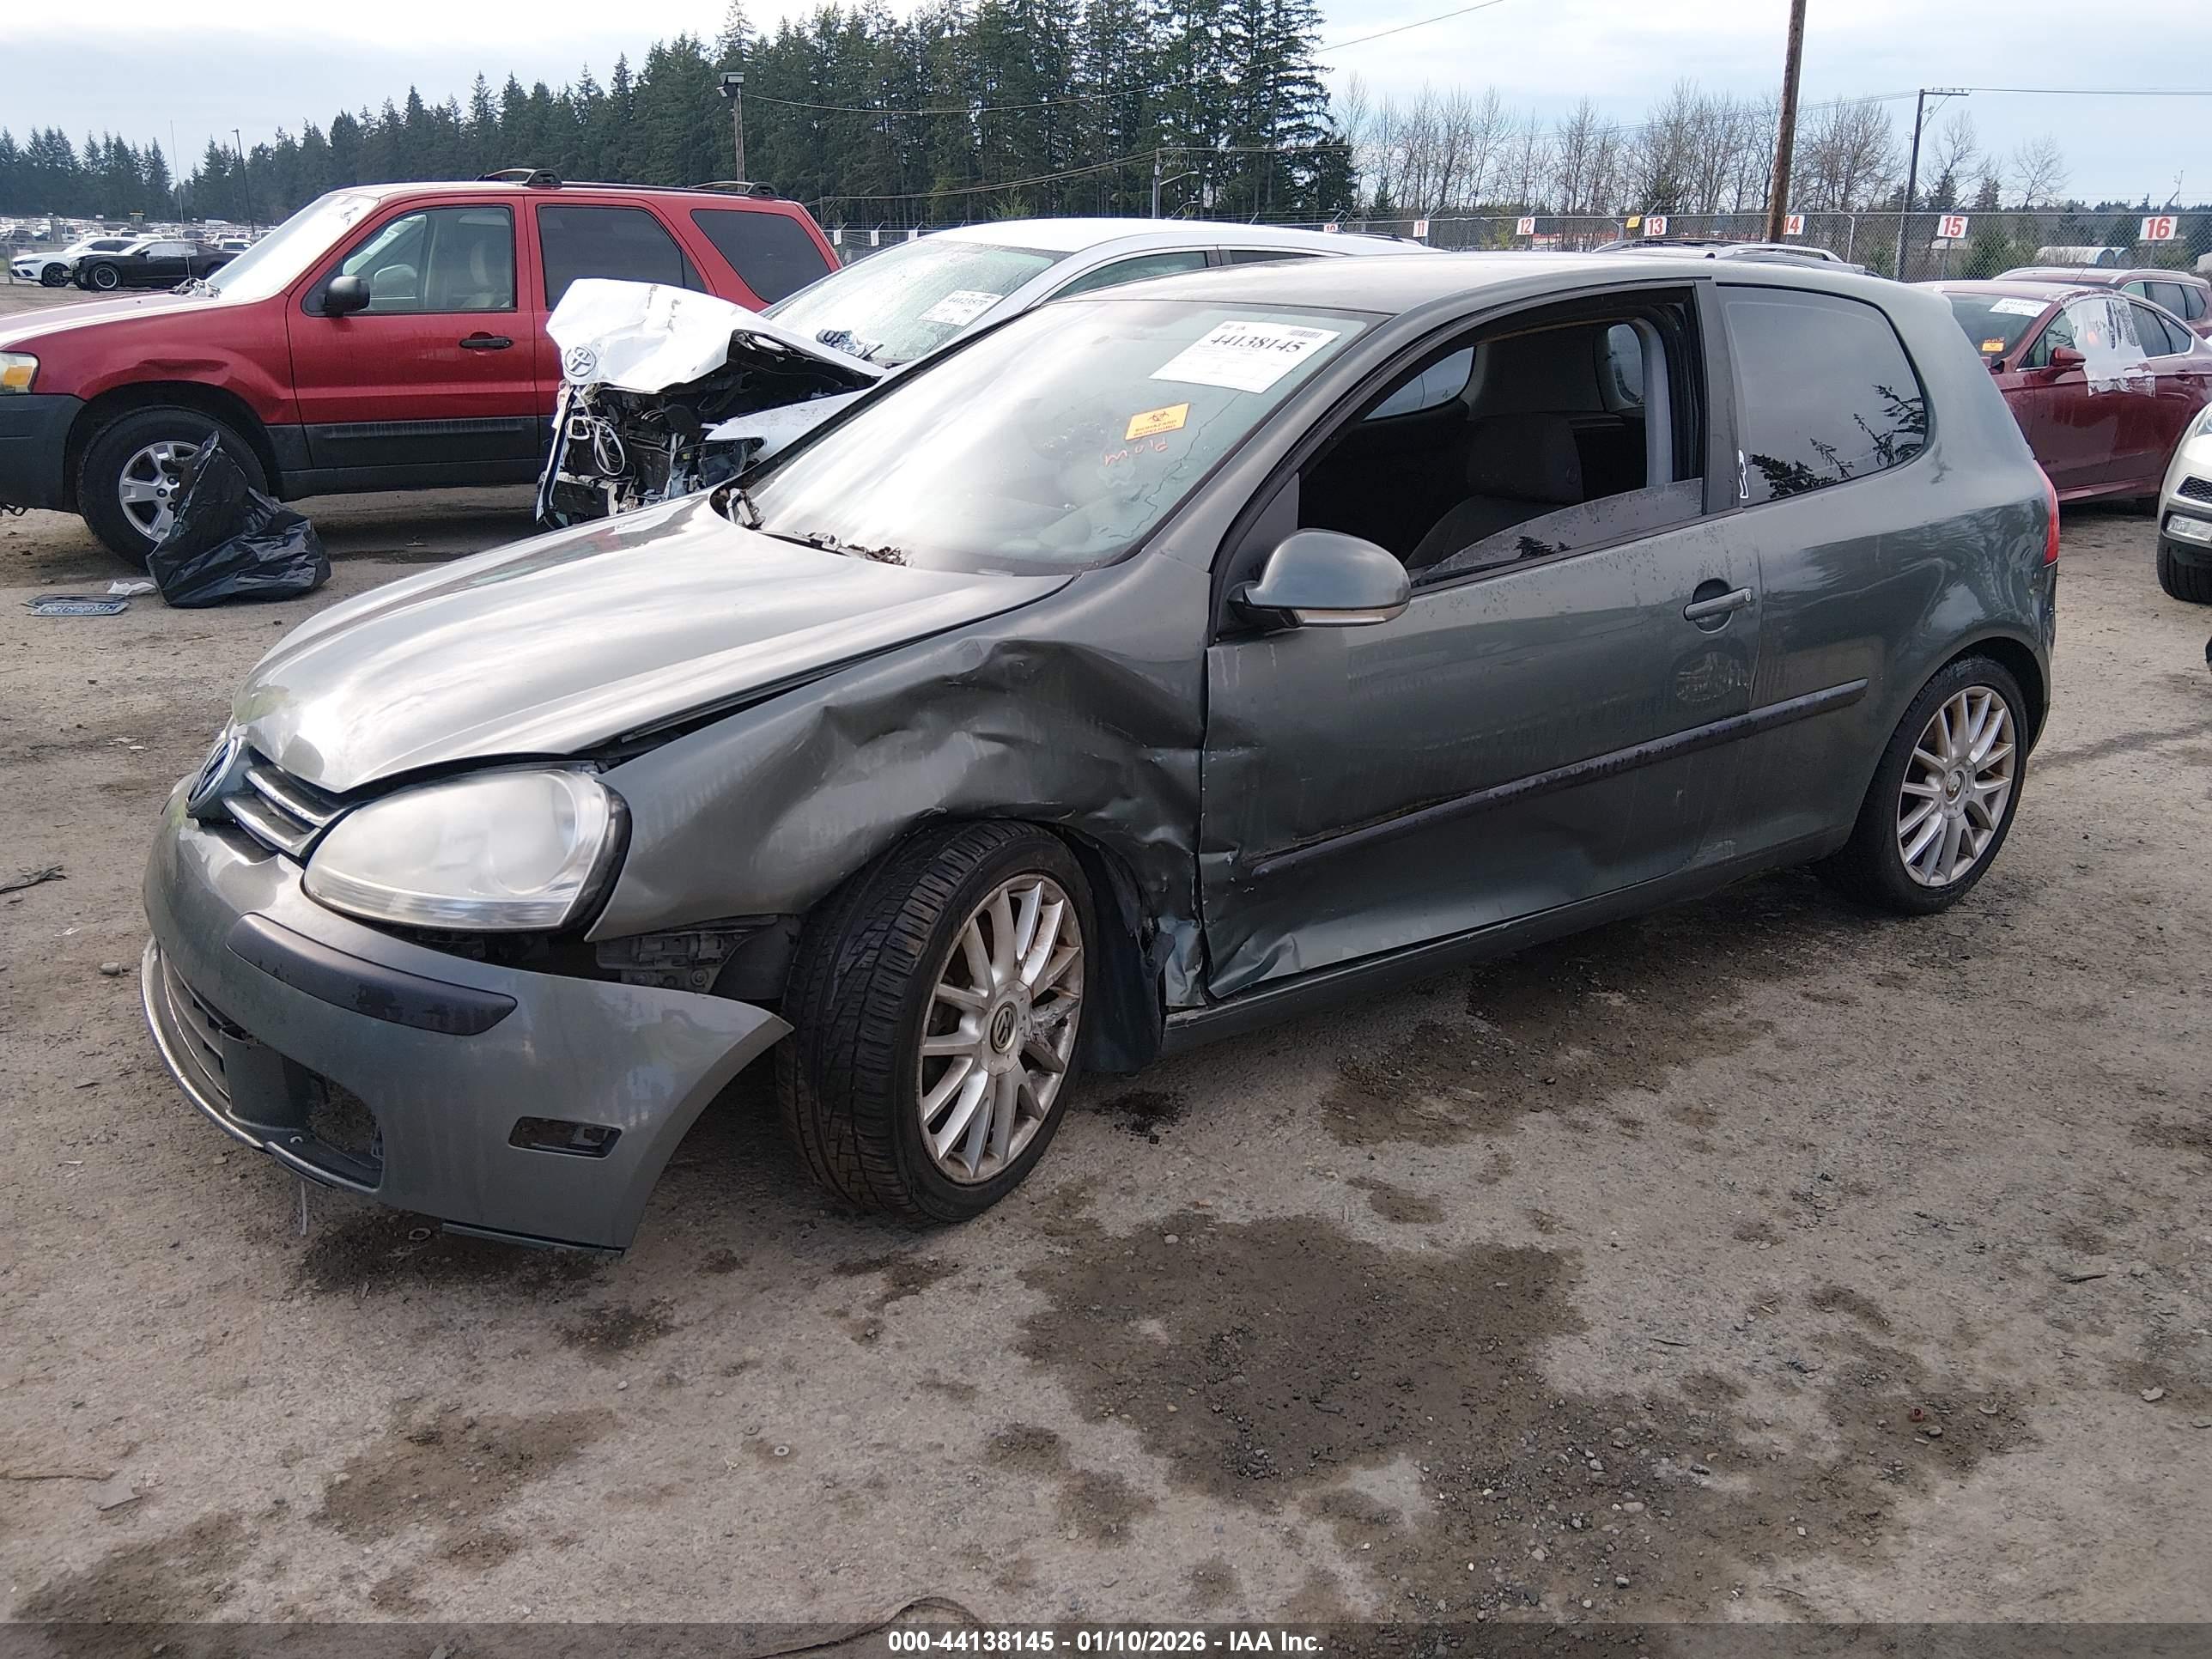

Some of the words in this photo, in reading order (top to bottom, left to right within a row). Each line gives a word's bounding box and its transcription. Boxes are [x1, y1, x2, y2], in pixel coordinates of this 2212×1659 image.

[1417, 221, 1425, 236] 11
[1520, 219, 1531, 234] 12
[1649, 218, 1663, 235] 13
[1783, 216, 1800, 234] 14
[1944, 217, 1963, 237] 15
[2148, 218, 2171, 239] 16
[1211, 334, 1308, 353] 44138145
